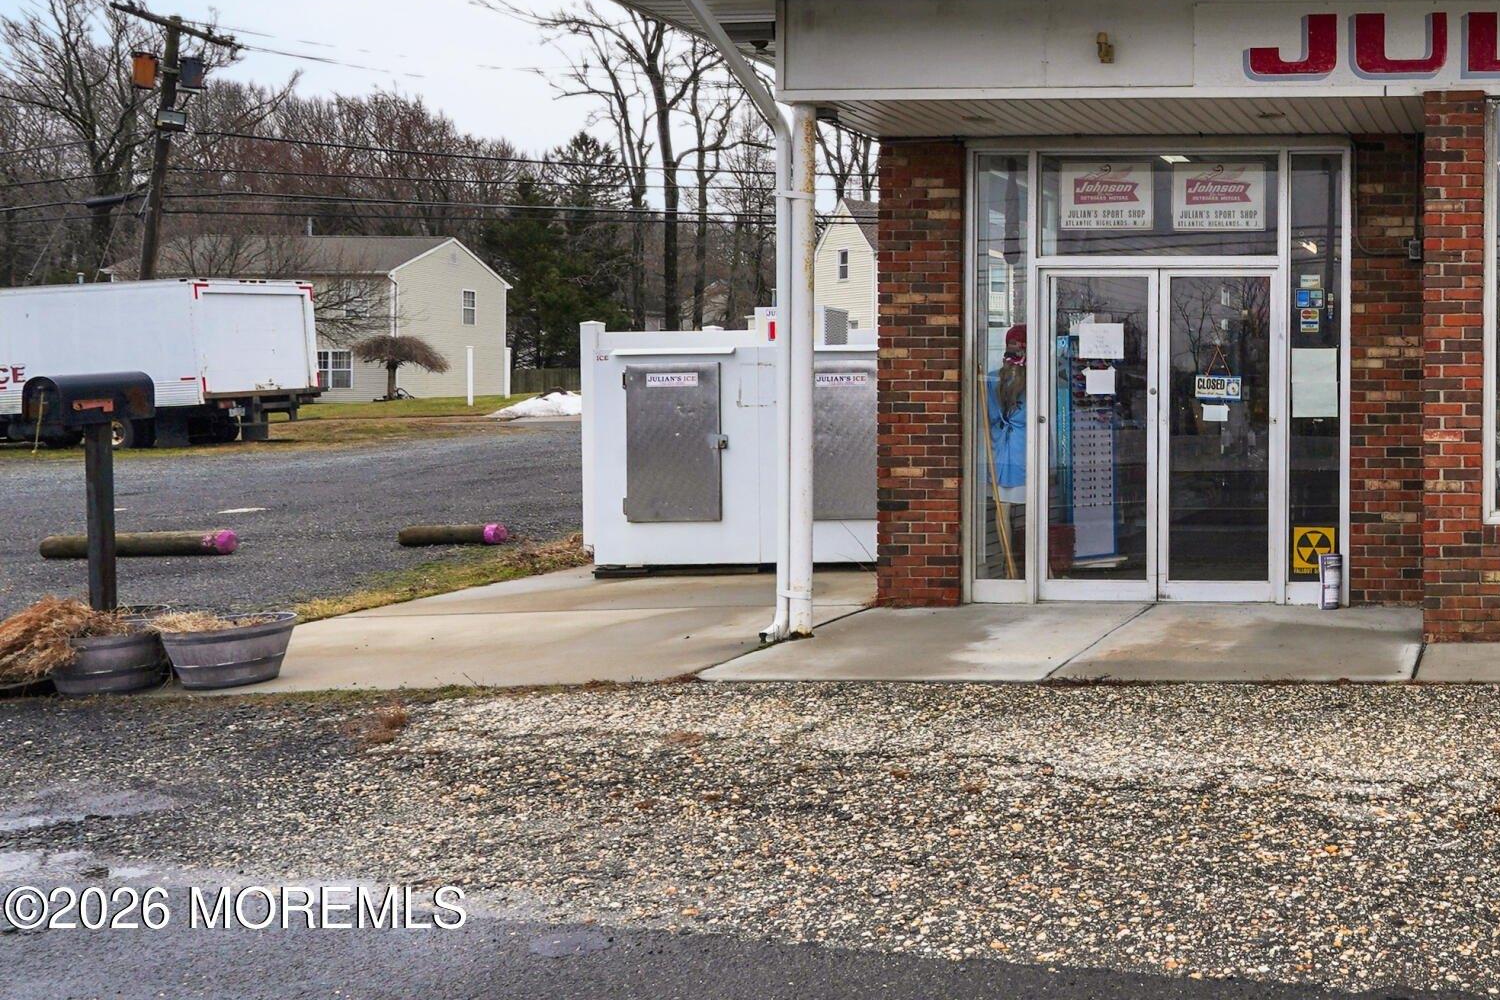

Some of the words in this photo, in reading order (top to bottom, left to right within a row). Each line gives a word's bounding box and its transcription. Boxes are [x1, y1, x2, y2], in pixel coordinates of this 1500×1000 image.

[1076, 181, 1133, 194] Johnson
[1187, 181, 1245, 194] Johnson
[1067, 209, 1098, 219] JULIAN'S
[1102, 209, 1124, 219] SPORT
[1128, 209, 1146, 219] SHOP
[1179, 209, 1210, 220] JULIAN'S
[1214, 209, 1236, 220] SPORT
[1240, 209, 1258, 220] SHOP
[1065, 219, 1093, 227] ATLANTIC
[1177, 219, 1205, 228] ATLANTIC
[648, 375, 682, 383] JULIAN'S
[816, 375, 851, 383] JULIAN'S
[1197, 378, 1226, 390] CLOSED
